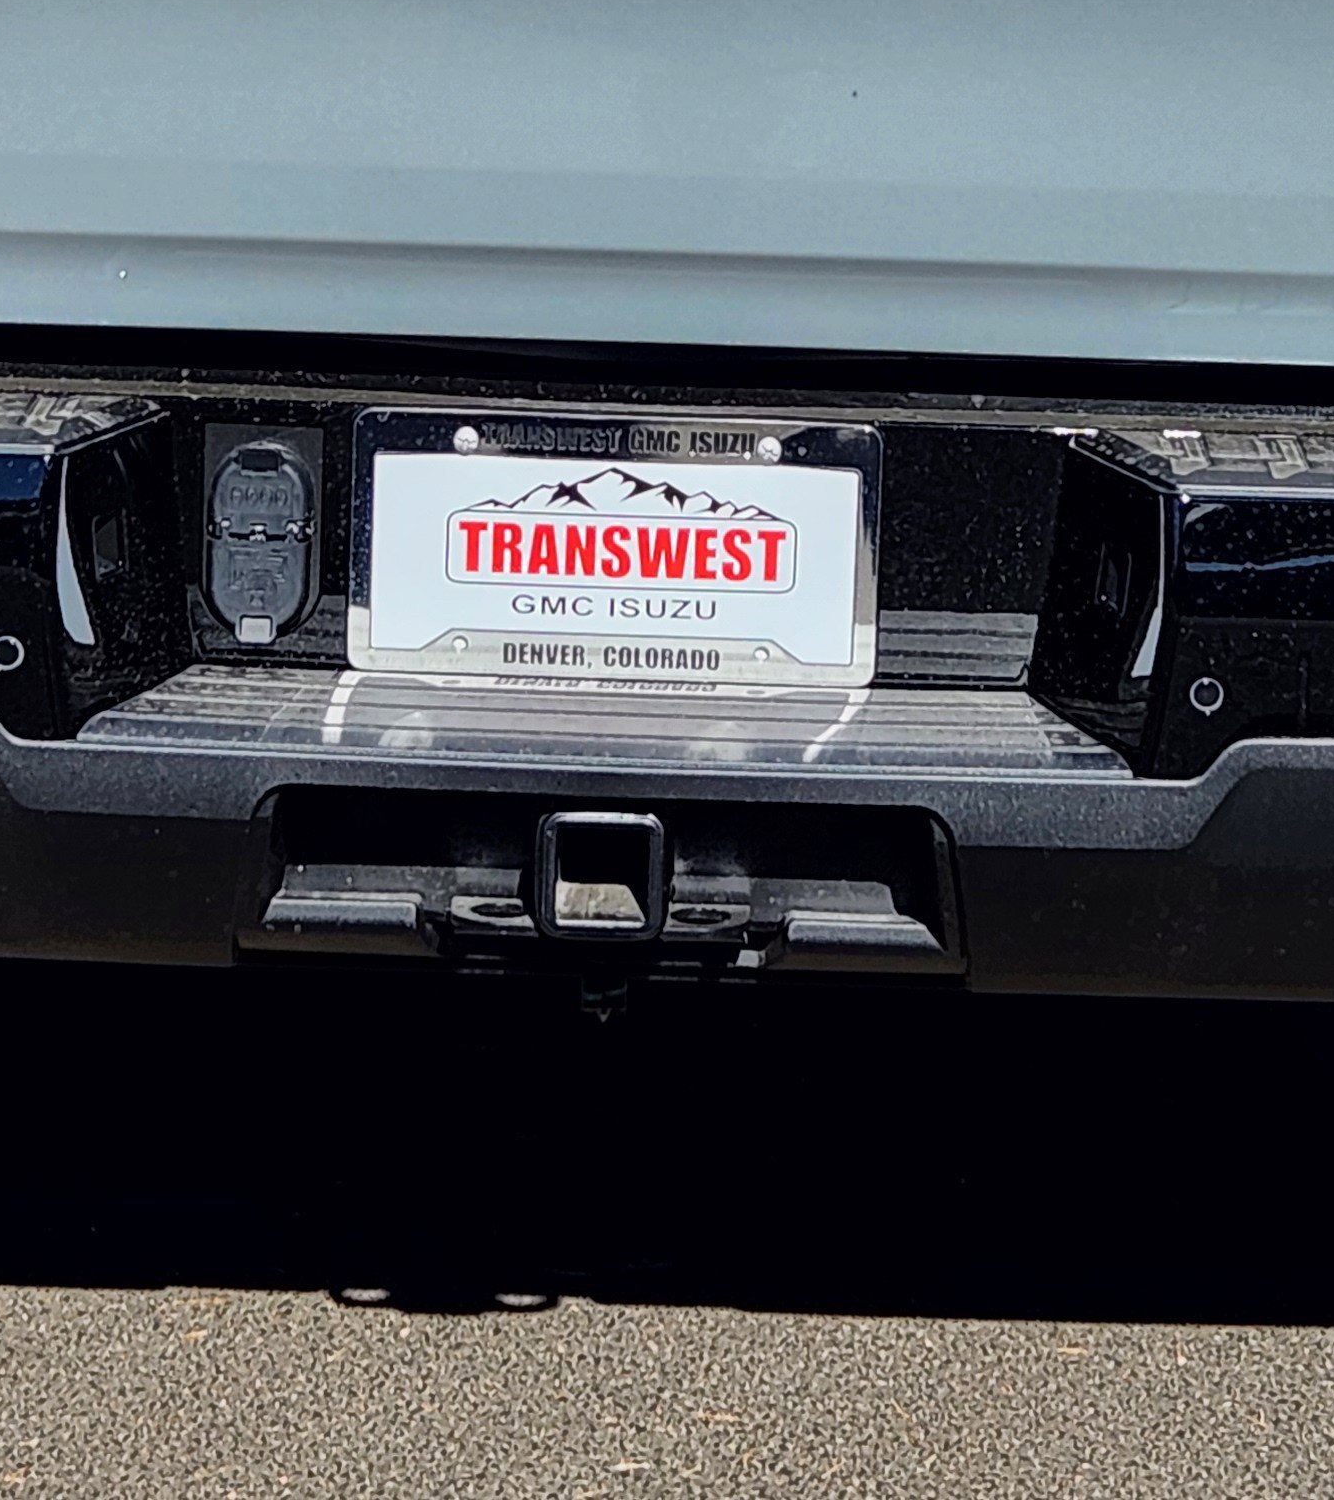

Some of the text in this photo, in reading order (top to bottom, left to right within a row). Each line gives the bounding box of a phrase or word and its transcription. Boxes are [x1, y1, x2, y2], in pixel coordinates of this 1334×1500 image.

[481, 422, 758, 457] TRANSWEST GMC ISUZU
[458, 520, 786, 583] TRANSWEST
[511, 593, 717, 621] GMC ISUZU
[502, 642, 721, 672] DENVER, COLORADO
